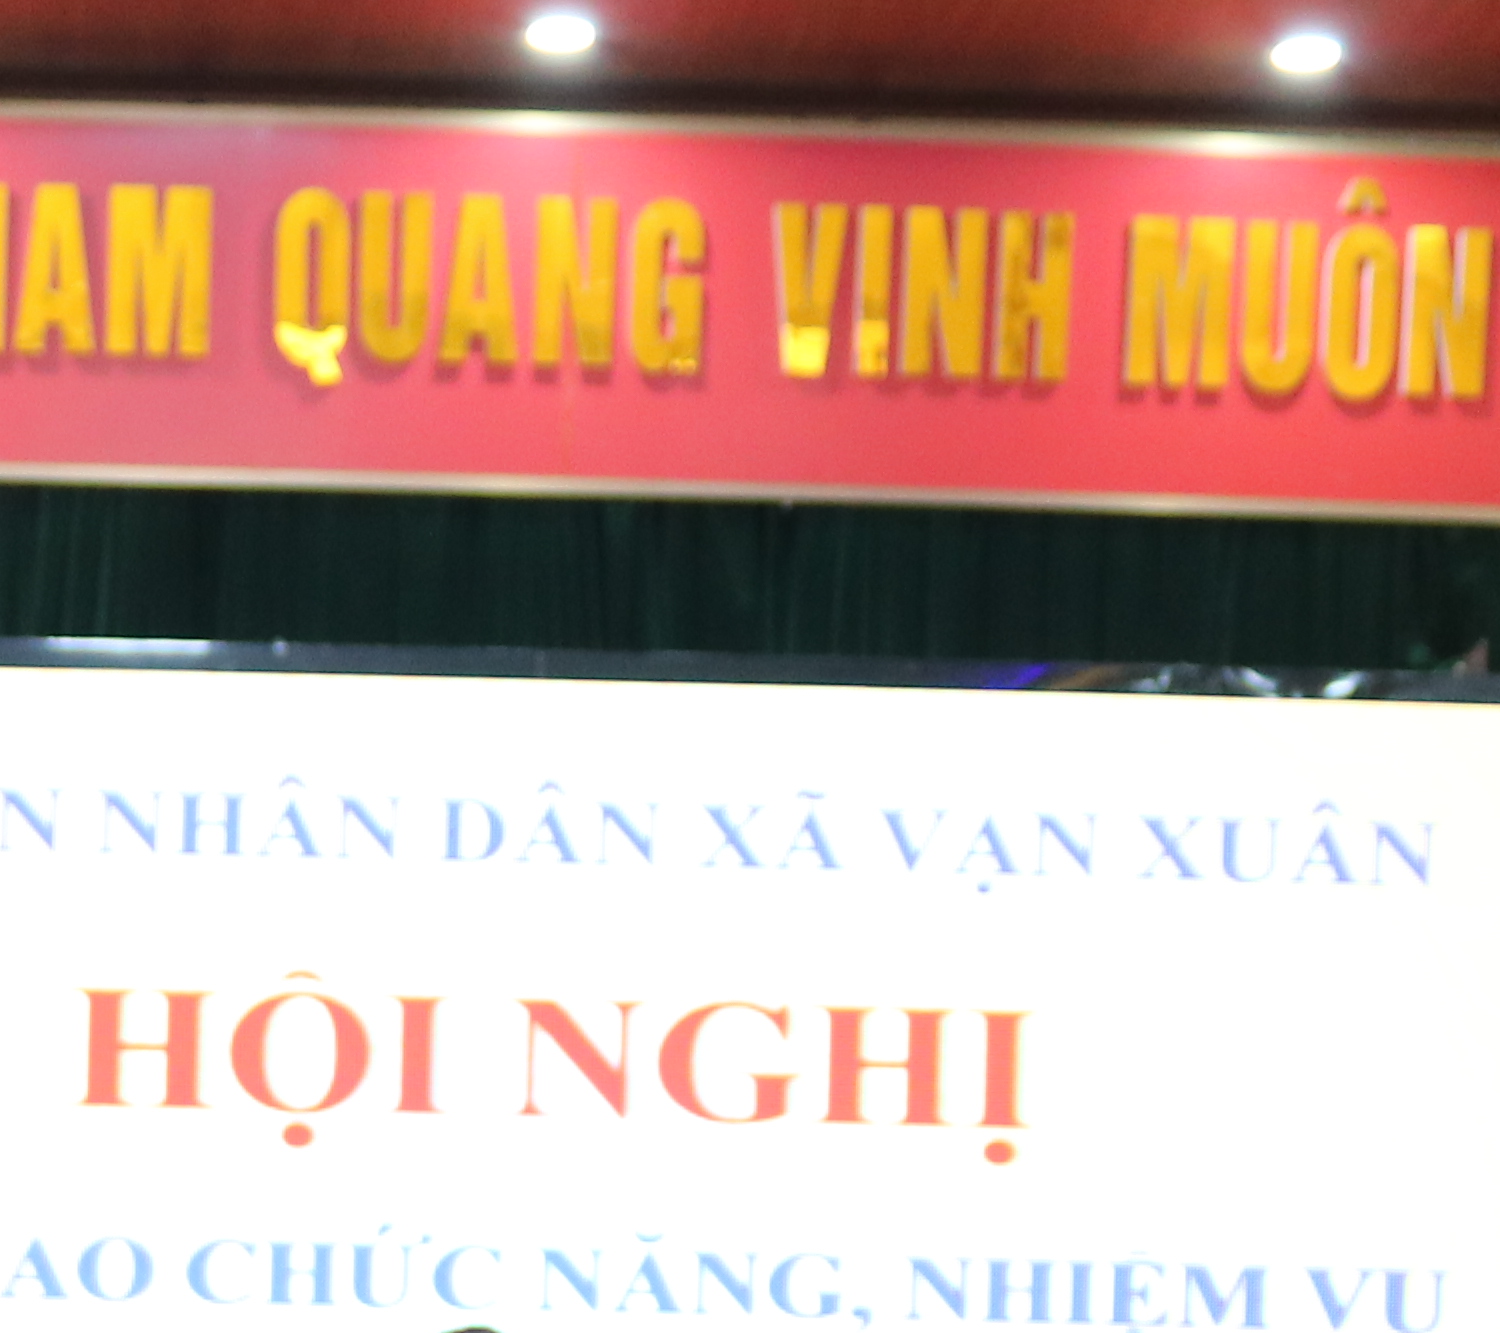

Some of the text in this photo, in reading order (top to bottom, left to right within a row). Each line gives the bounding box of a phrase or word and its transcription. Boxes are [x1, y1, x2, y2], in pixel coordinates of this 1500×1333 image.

[275, 187, 705, 385] QUANG
[774, 202, 1075, 380] VINH
[1124, 176, 1490, 401] MUÔN
[99, 774, 401, 860] NHÂN
[441, 780, 658, 865] DÂN
[700, 789, 843, 870] XÃ
[881, 808, 1097, 895] VẠN
[1137, 798, 1435, 885] XUÂN
[75, 969, 1034, 1166] HỘI NGHỊ
[185, 1223, 502, 1311] CHỨC
[538, 1233, 875, 1330] NĂNG,
